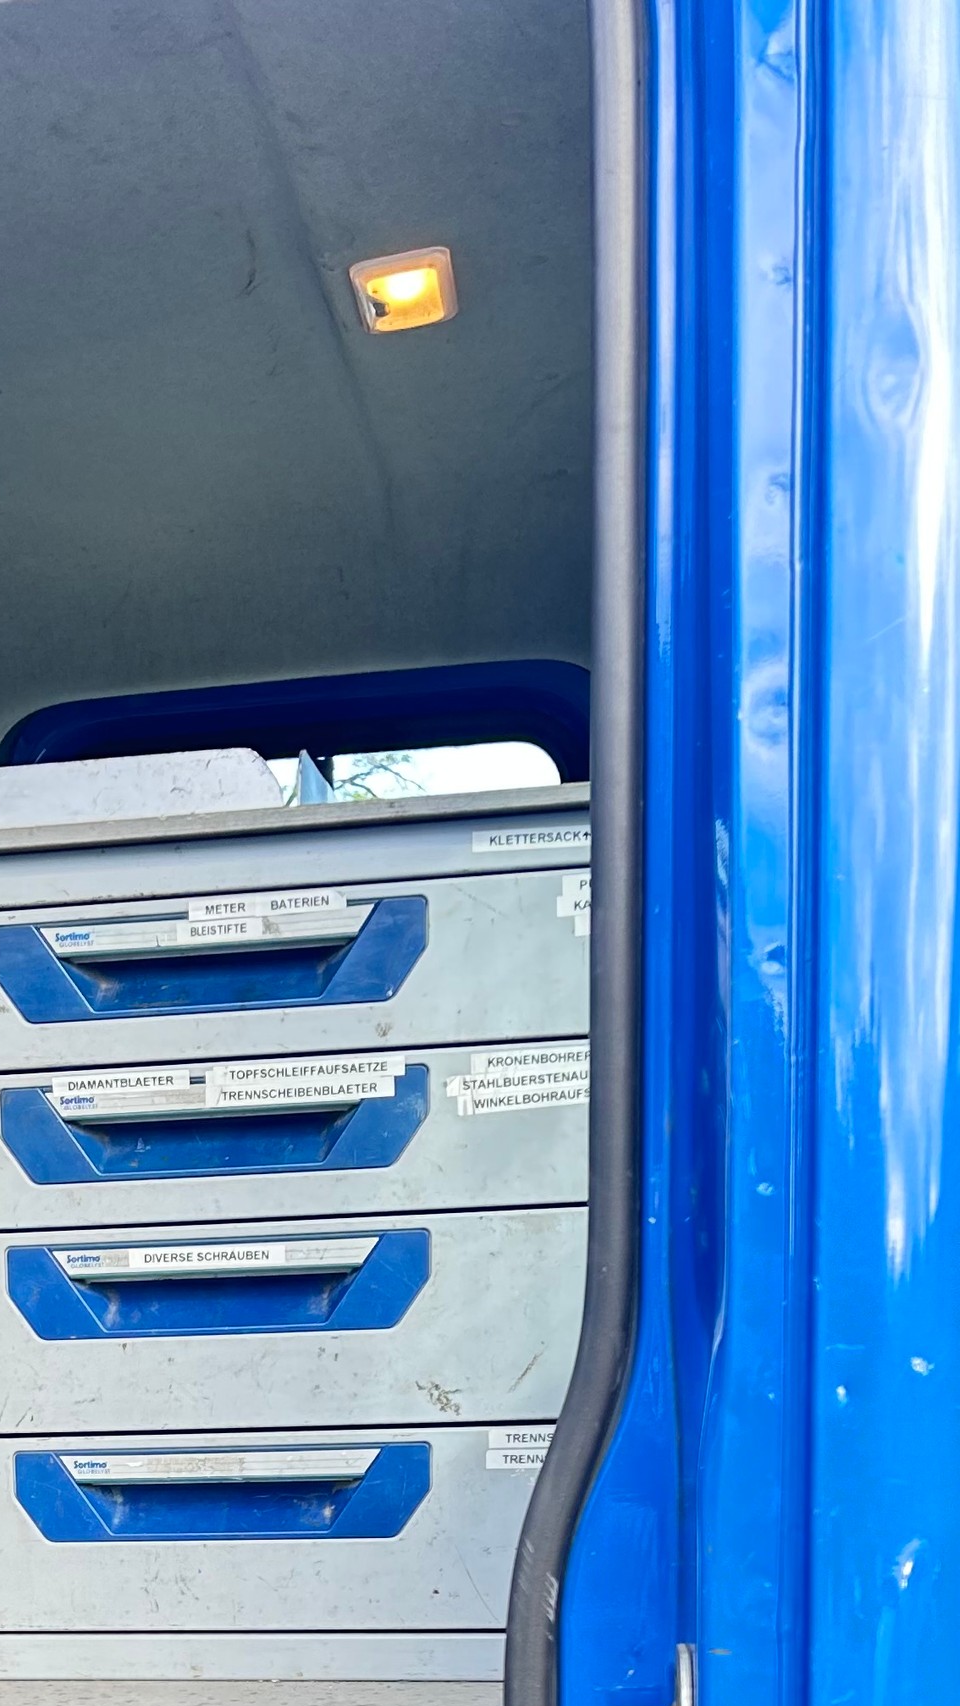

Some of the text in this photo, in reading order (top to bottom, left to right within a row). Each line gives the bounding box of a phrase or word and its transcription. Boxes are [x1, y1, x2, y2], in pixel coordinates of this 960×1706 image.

[489, 831, 581, 847] KLETTERSACK
[205, 895, 330, 915] METER BATERIEN
[55, 932, 90, 942] Sortimo
[190, 922, 248, 937] BLEISTIFTE
[229, 1061, 388, 1080] TOPFSCHLEIFFAUFSAETZE
[67, 1075, 174, 1091] DIAMANTBLAETER
[462, 1070, 588, 1091] STAHLBUERSTENAU
[222, 1082, 378, 1102] TRENNSCHEIBENBLAETER
[60, 1095, 95, 1105] Sortimo
[67, 1254, 101, 1264] Sortimo
[143, 1249, 270, 1263] DIVERSE SCHRAUBEN
[73, 1460, 107, 1469] Sortimo
[502, 1454, 546, 1464] TRENN
